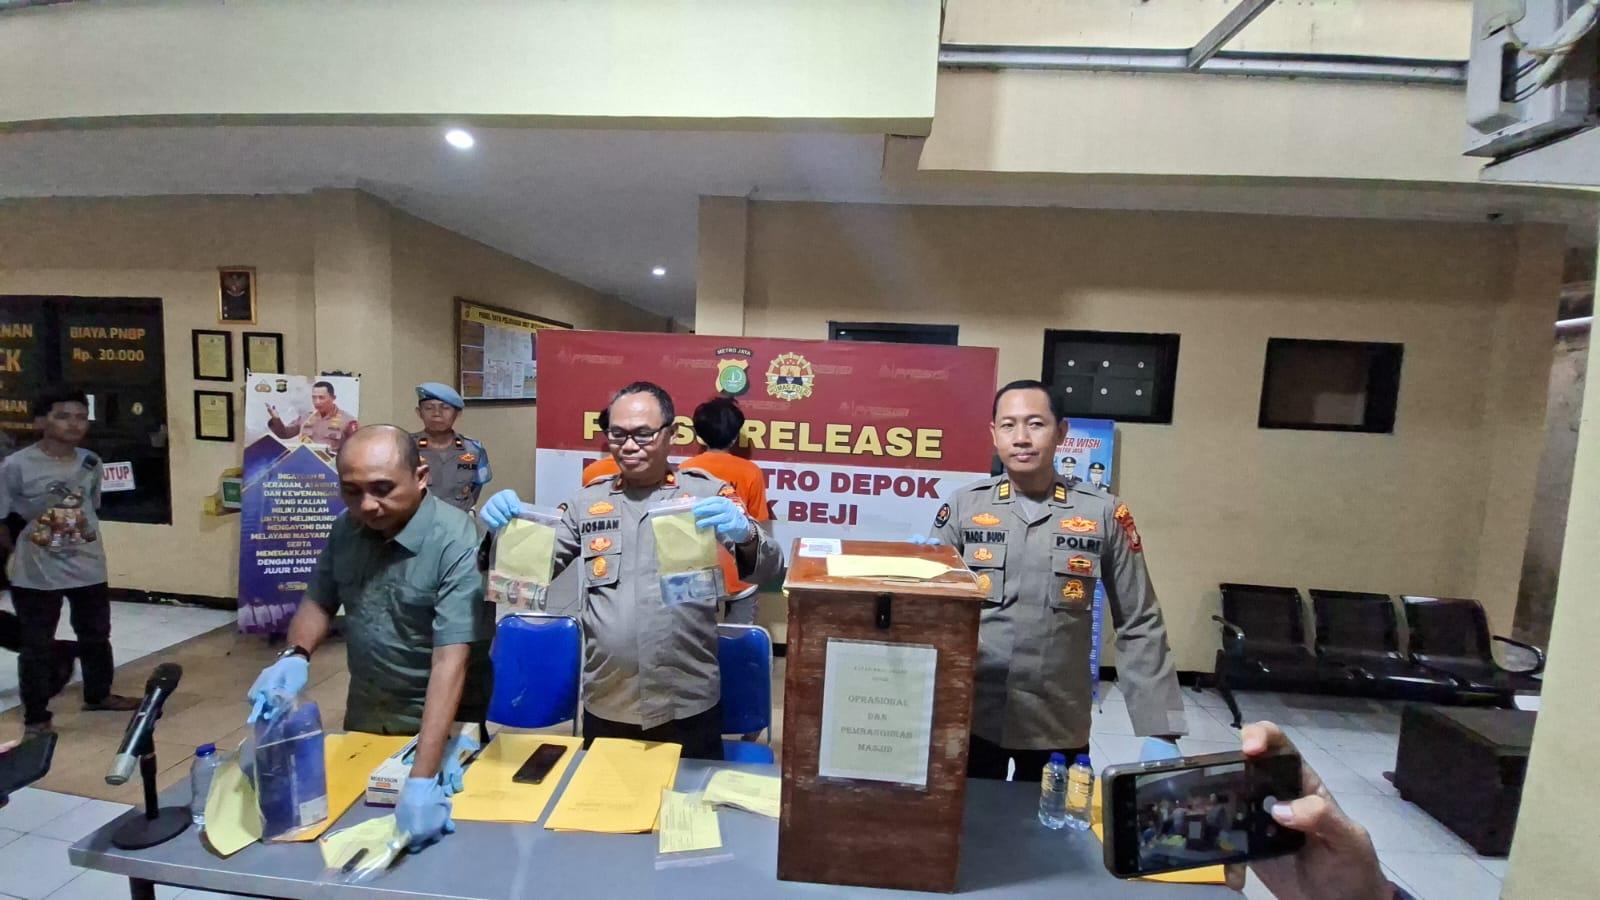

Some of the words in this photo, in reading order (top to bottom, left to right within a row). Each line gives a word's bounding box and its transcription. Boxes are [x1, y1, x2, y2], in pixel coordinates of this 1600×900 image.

[739, 420, 943, 459] RELEASE
[103, 466, 130, 481] UTUP
[765, 468, 820, 493] TRO
[830, 471, 941, 500] DEPOK
[788, 501, 858, 525] BEJI
[581, 519, 620, 534] JOSMAN
